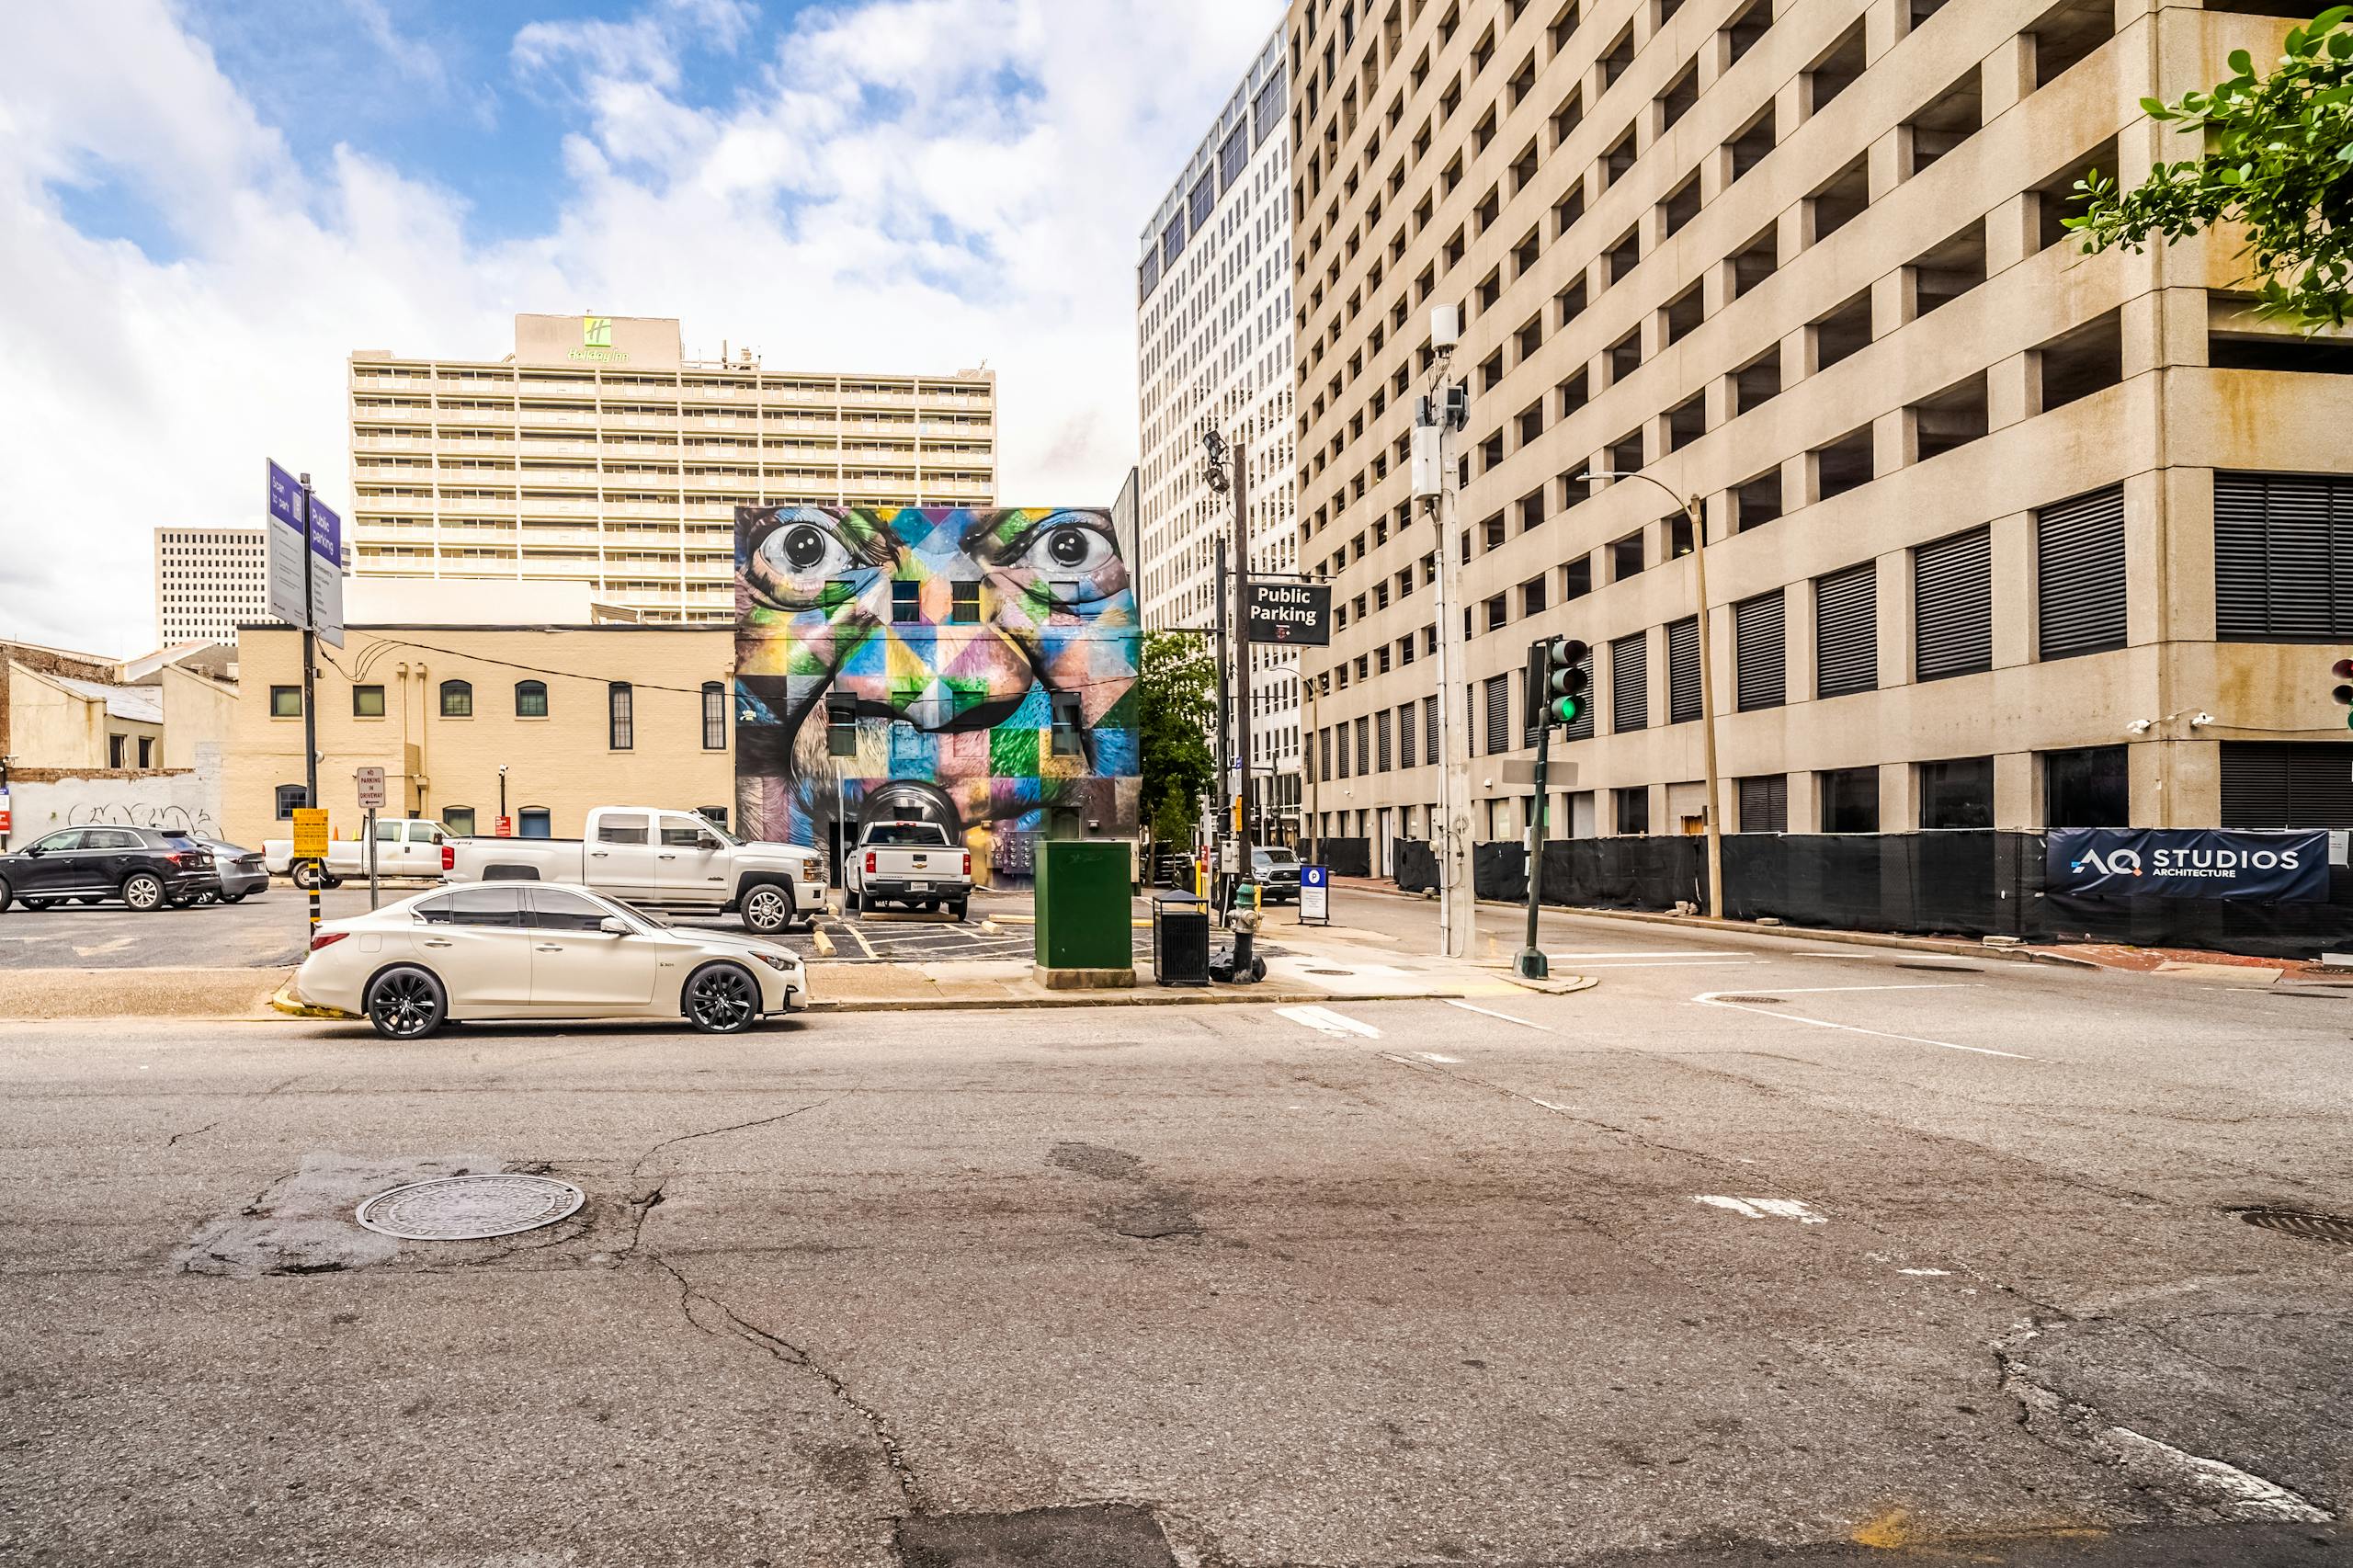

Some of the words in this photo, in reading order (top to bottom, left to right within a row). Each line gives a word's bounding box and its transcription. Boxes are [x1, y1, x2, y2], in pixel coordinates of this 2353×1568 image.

[567, 347, 610, 363] Holiday
[611, 347, 630, 361] Inn
[272, 476, 285, 494] Scan
[313, 507, 330, 533] Public
[313, 528, 335, 556] parking
[1257, 586, 1311, 604] Public
[1250, 605, 1317, 626] Parking
[2071, 848, 2143, 877] AQ
[2152, 848, 2300, 870] STUDIOS
[2152, 868, 2236, 879] ARCHITECTURE
